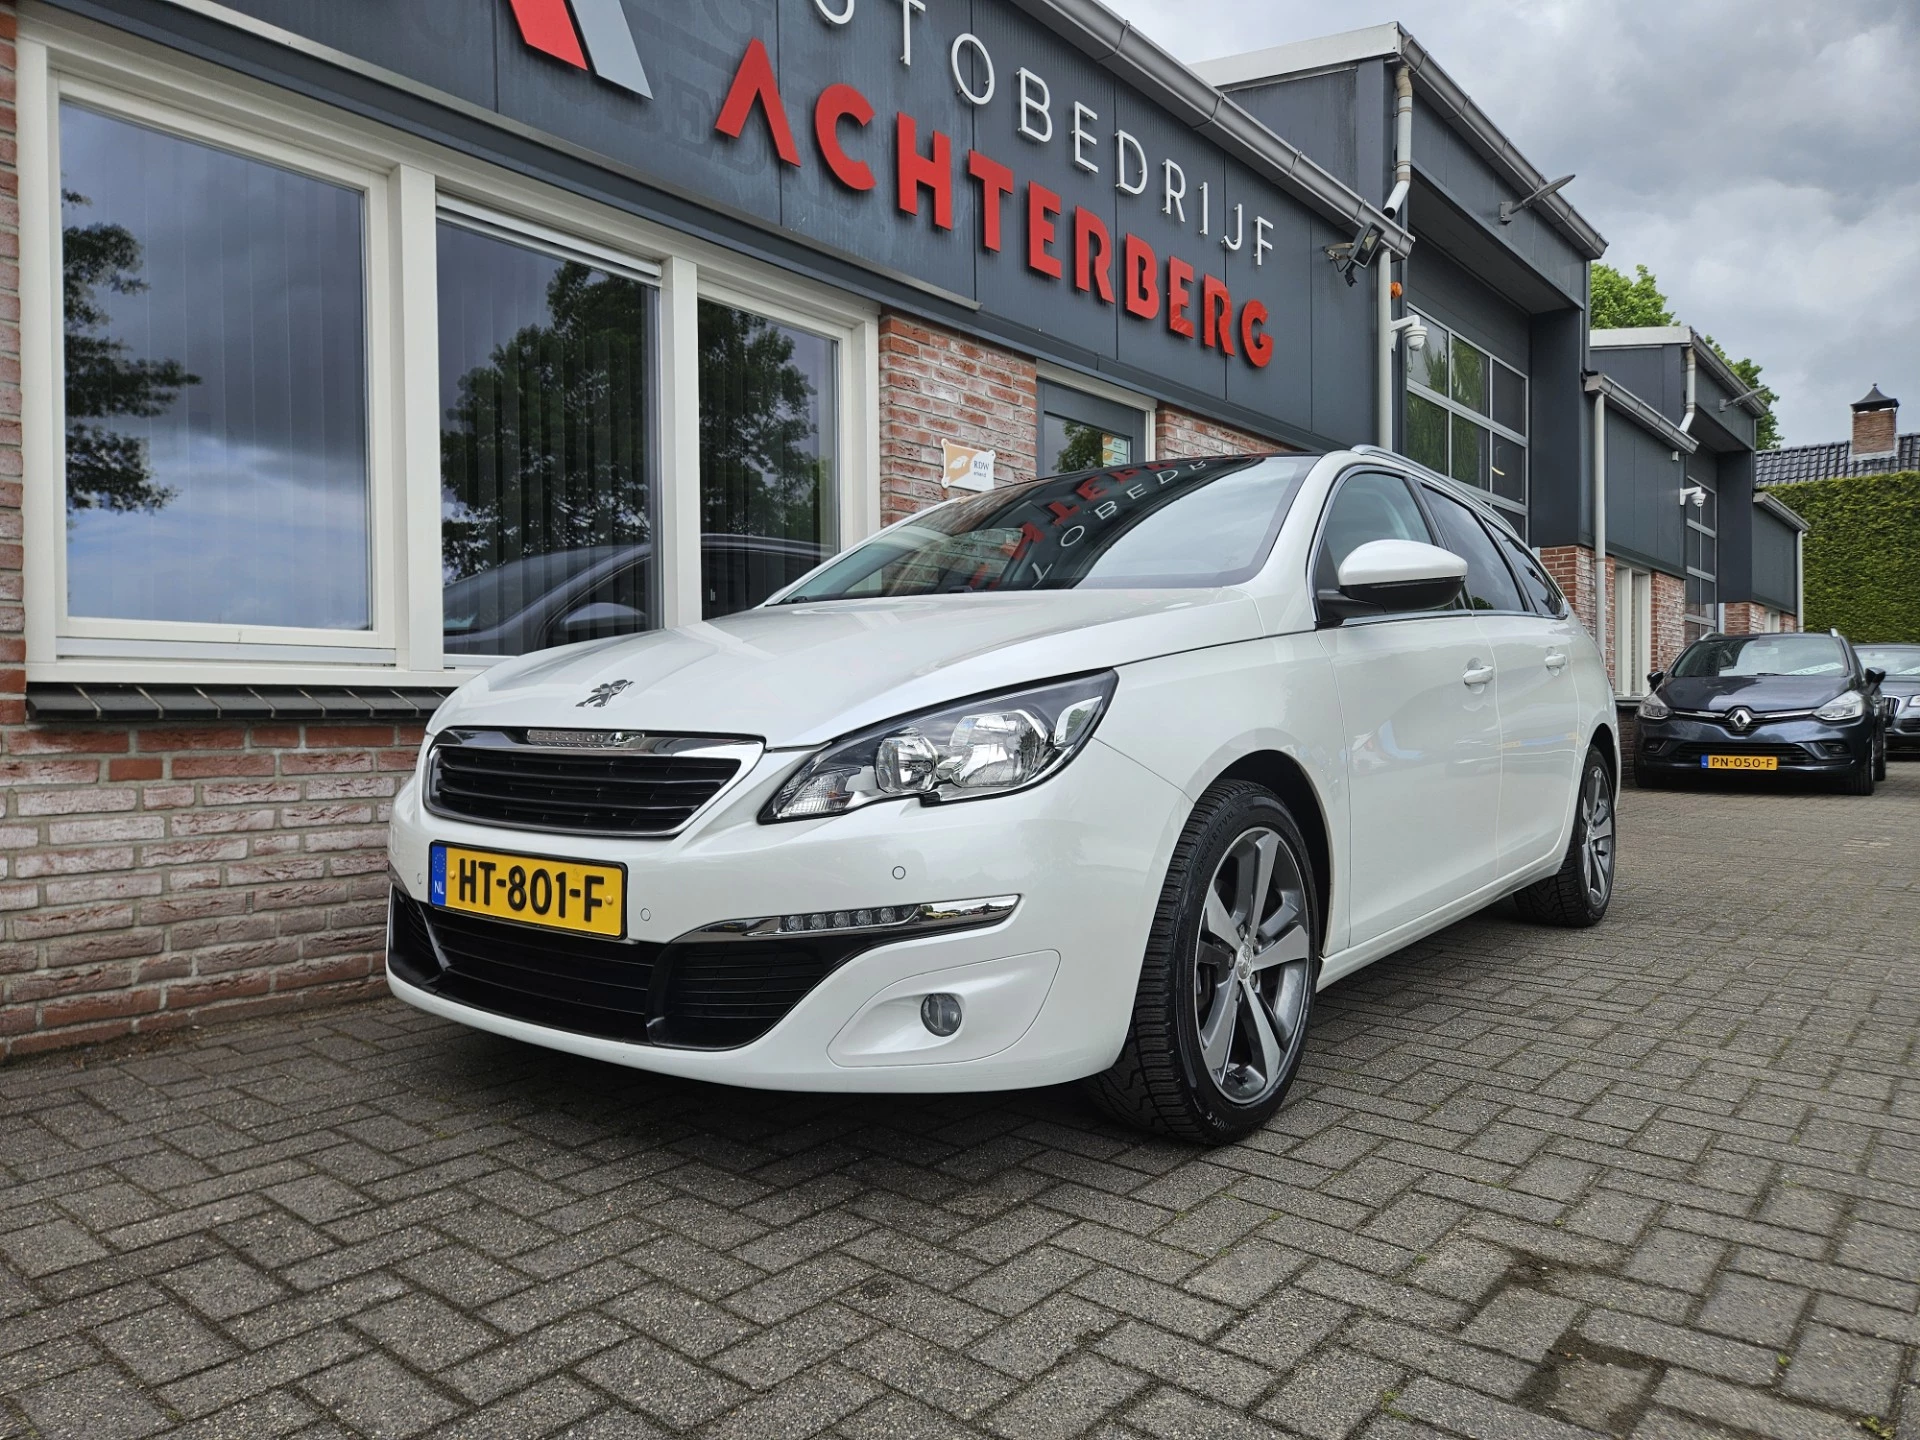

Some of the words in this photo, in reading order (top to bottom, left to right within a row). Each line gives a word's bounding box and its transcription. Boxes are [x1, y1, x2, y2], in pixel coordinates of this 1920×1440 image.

[814, 0, 1274, 266] TOBEDRIJF
[714, 36, 1274, 368] ACHTERBERG
[973, 460, 990, 470] RDW
[1711, 757, 1774, 768] PN-050-F
[434, 882, 445, 895] NL
[459, 857, 605, 923] HT-801-F
